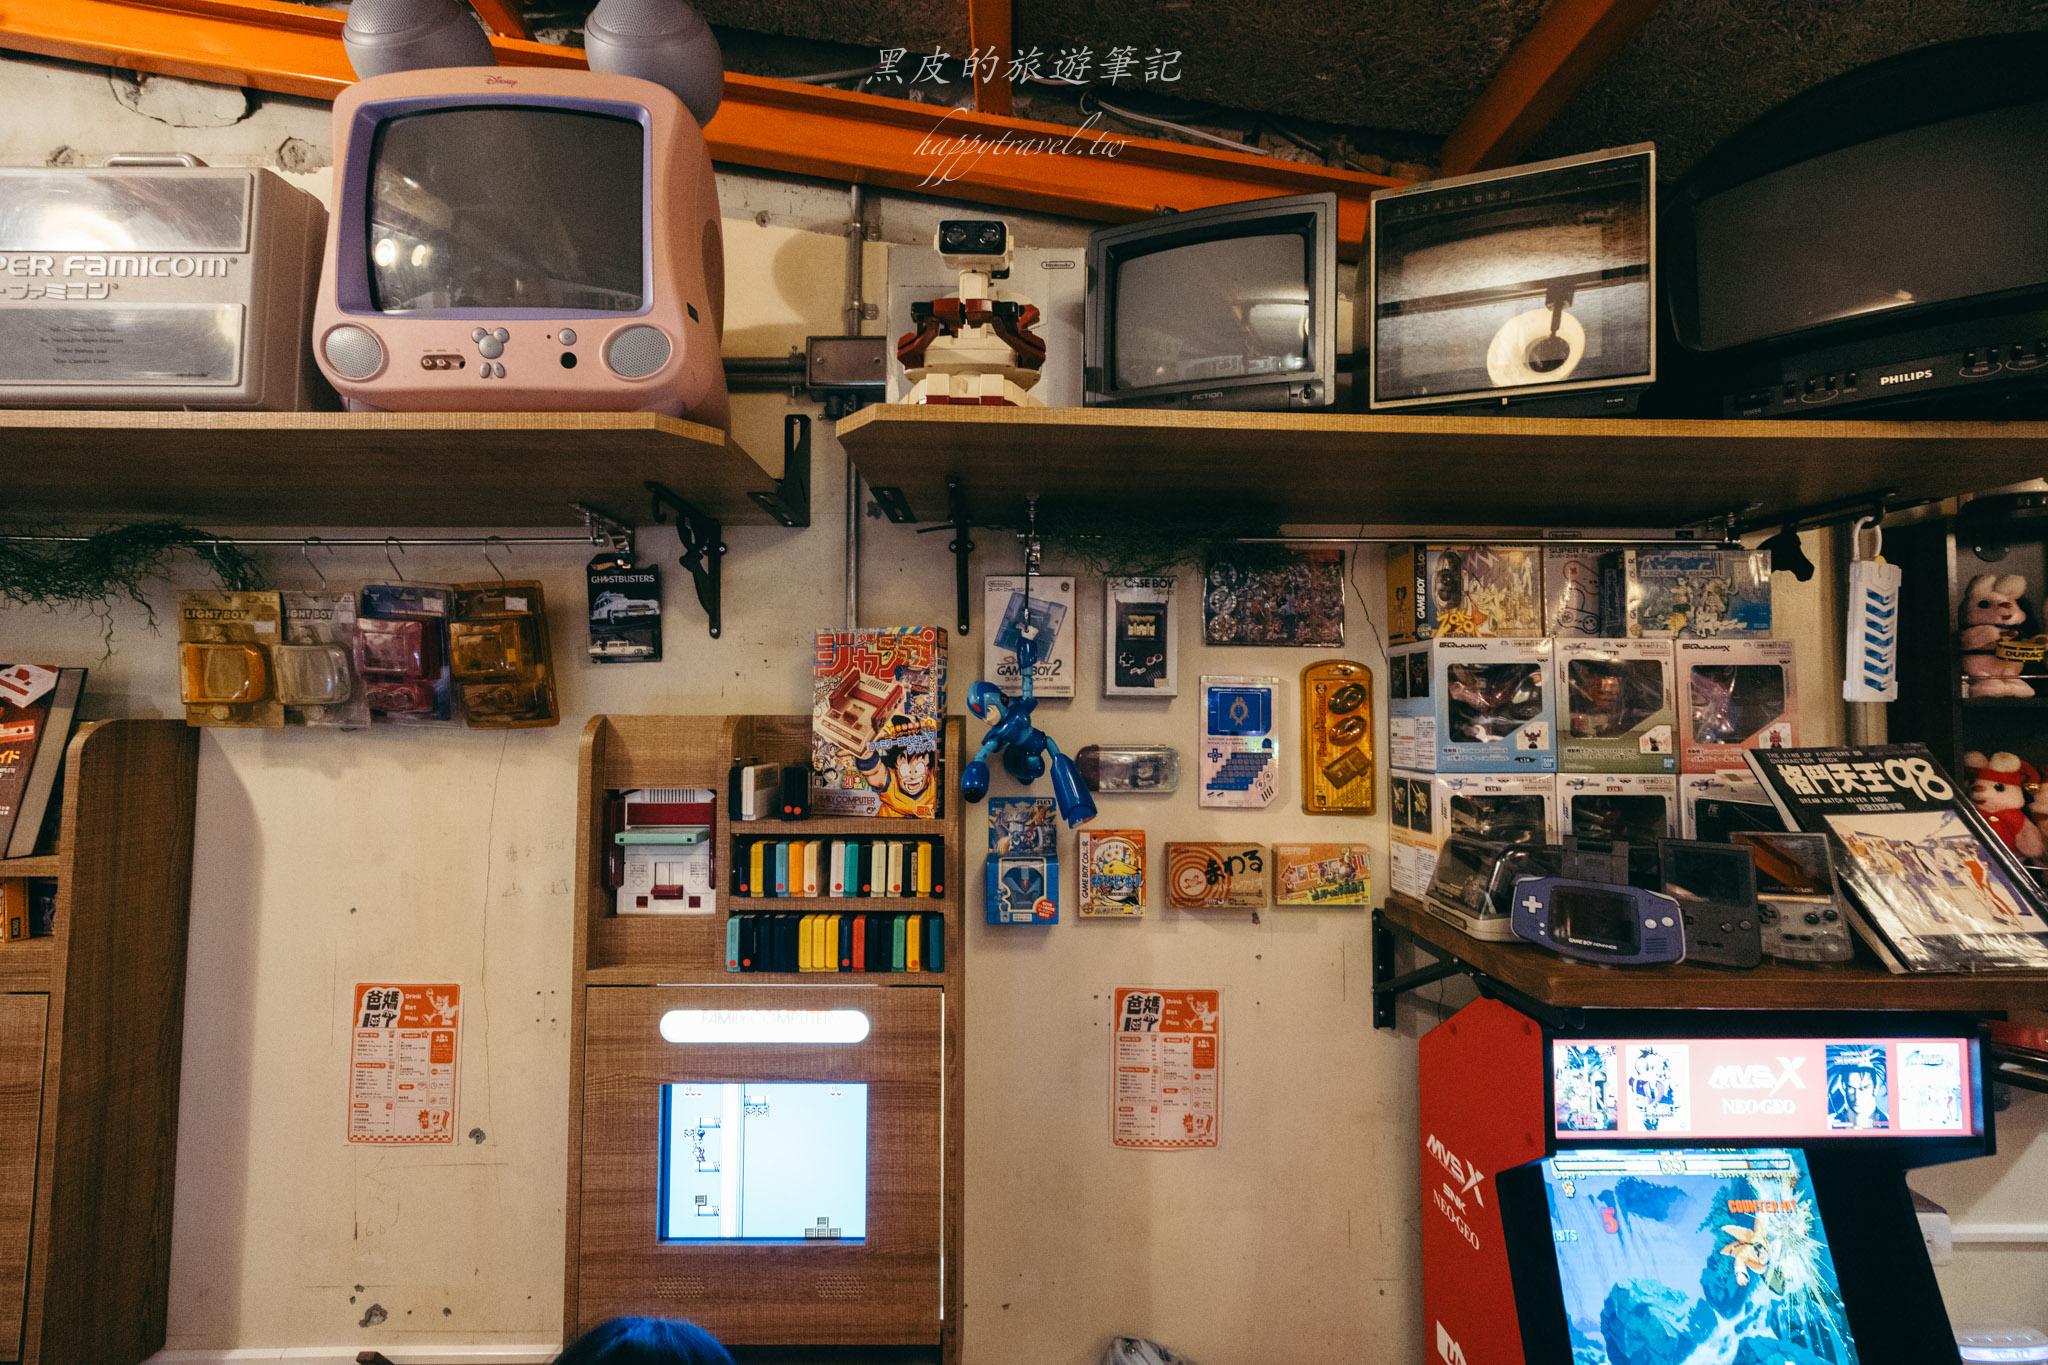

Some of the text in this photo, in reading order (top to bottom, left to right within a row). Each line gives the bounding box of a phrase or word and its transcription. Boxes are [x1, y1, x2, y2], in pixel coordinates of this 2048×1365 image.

[484, 74, 518, 88] Disney
[1880, 369, 1933, 386] PHILIPS
[1192, 391, 1223, 400] ACTION
[1152, 578, 1174, 588] BOY
[1416, 577, 1425, 595] BOY
[184, 609, 249, 620] LIGHT BOY
[287, 609, 334, 620] IGHT BOY
[1416, 595, 1425, 619] GAME
[997, 665, 1023, 676] GAM
[1051, 659, 1063, 676] 2
[838, 796, 876, 805] COMPUTER
[1081, 865, 1089, 879] BOY
[1205, 849, 1264, 886] まわる
[1081, 880, 1089, 899] GAME
[1568, 937, 1583, 945] GAME
[1593, 942, 1618, 951] ADVANCE
[366, 990, 400, 1010] 爸媽
[1126, 994, 1161, 1015] 爸媽
[1443, 1182, 1467, 1216] SNK
[1728, 1199, 1778, 1214] COUNTER
[1601, 1206, 1618, 1234] 5
